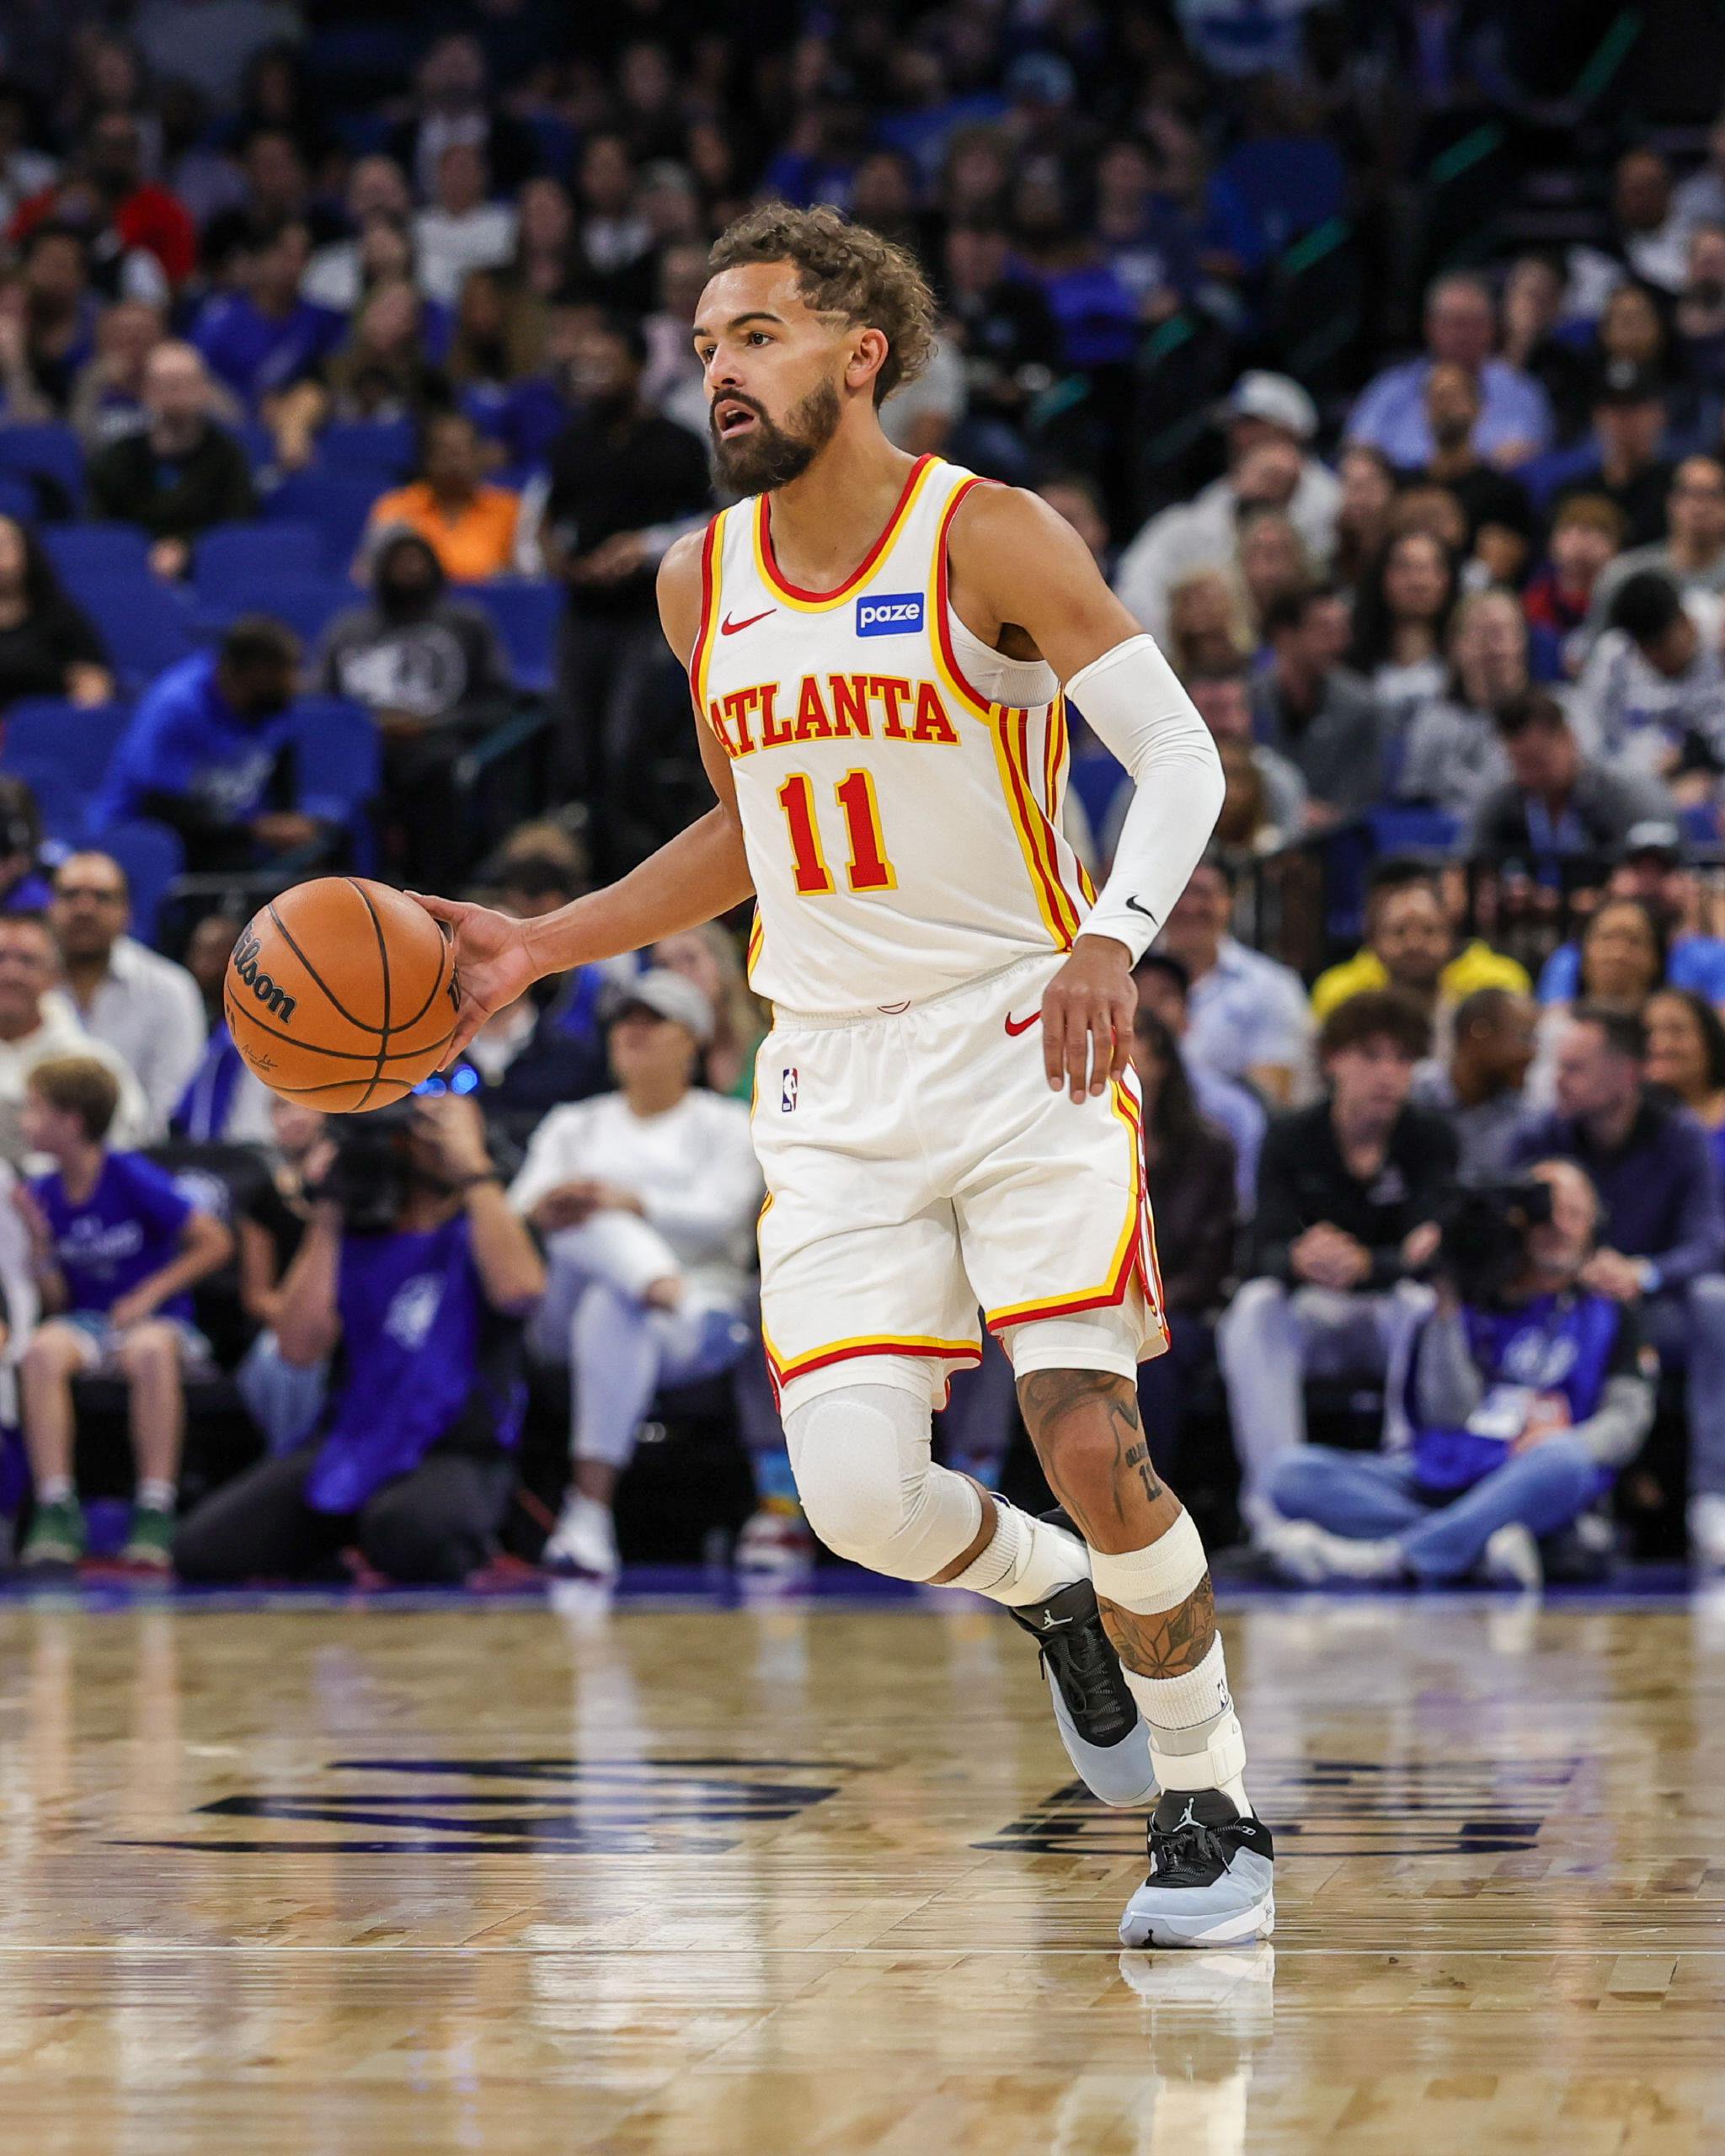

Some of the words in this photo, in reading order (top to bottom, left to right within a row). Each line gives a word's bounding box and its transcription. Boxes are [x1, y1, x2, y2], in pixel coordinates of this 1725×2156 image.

[860, 603, 921, 629] paze
[709, 674, 961, 761] ATLANTA
[776, 767, 899, 897] 11
